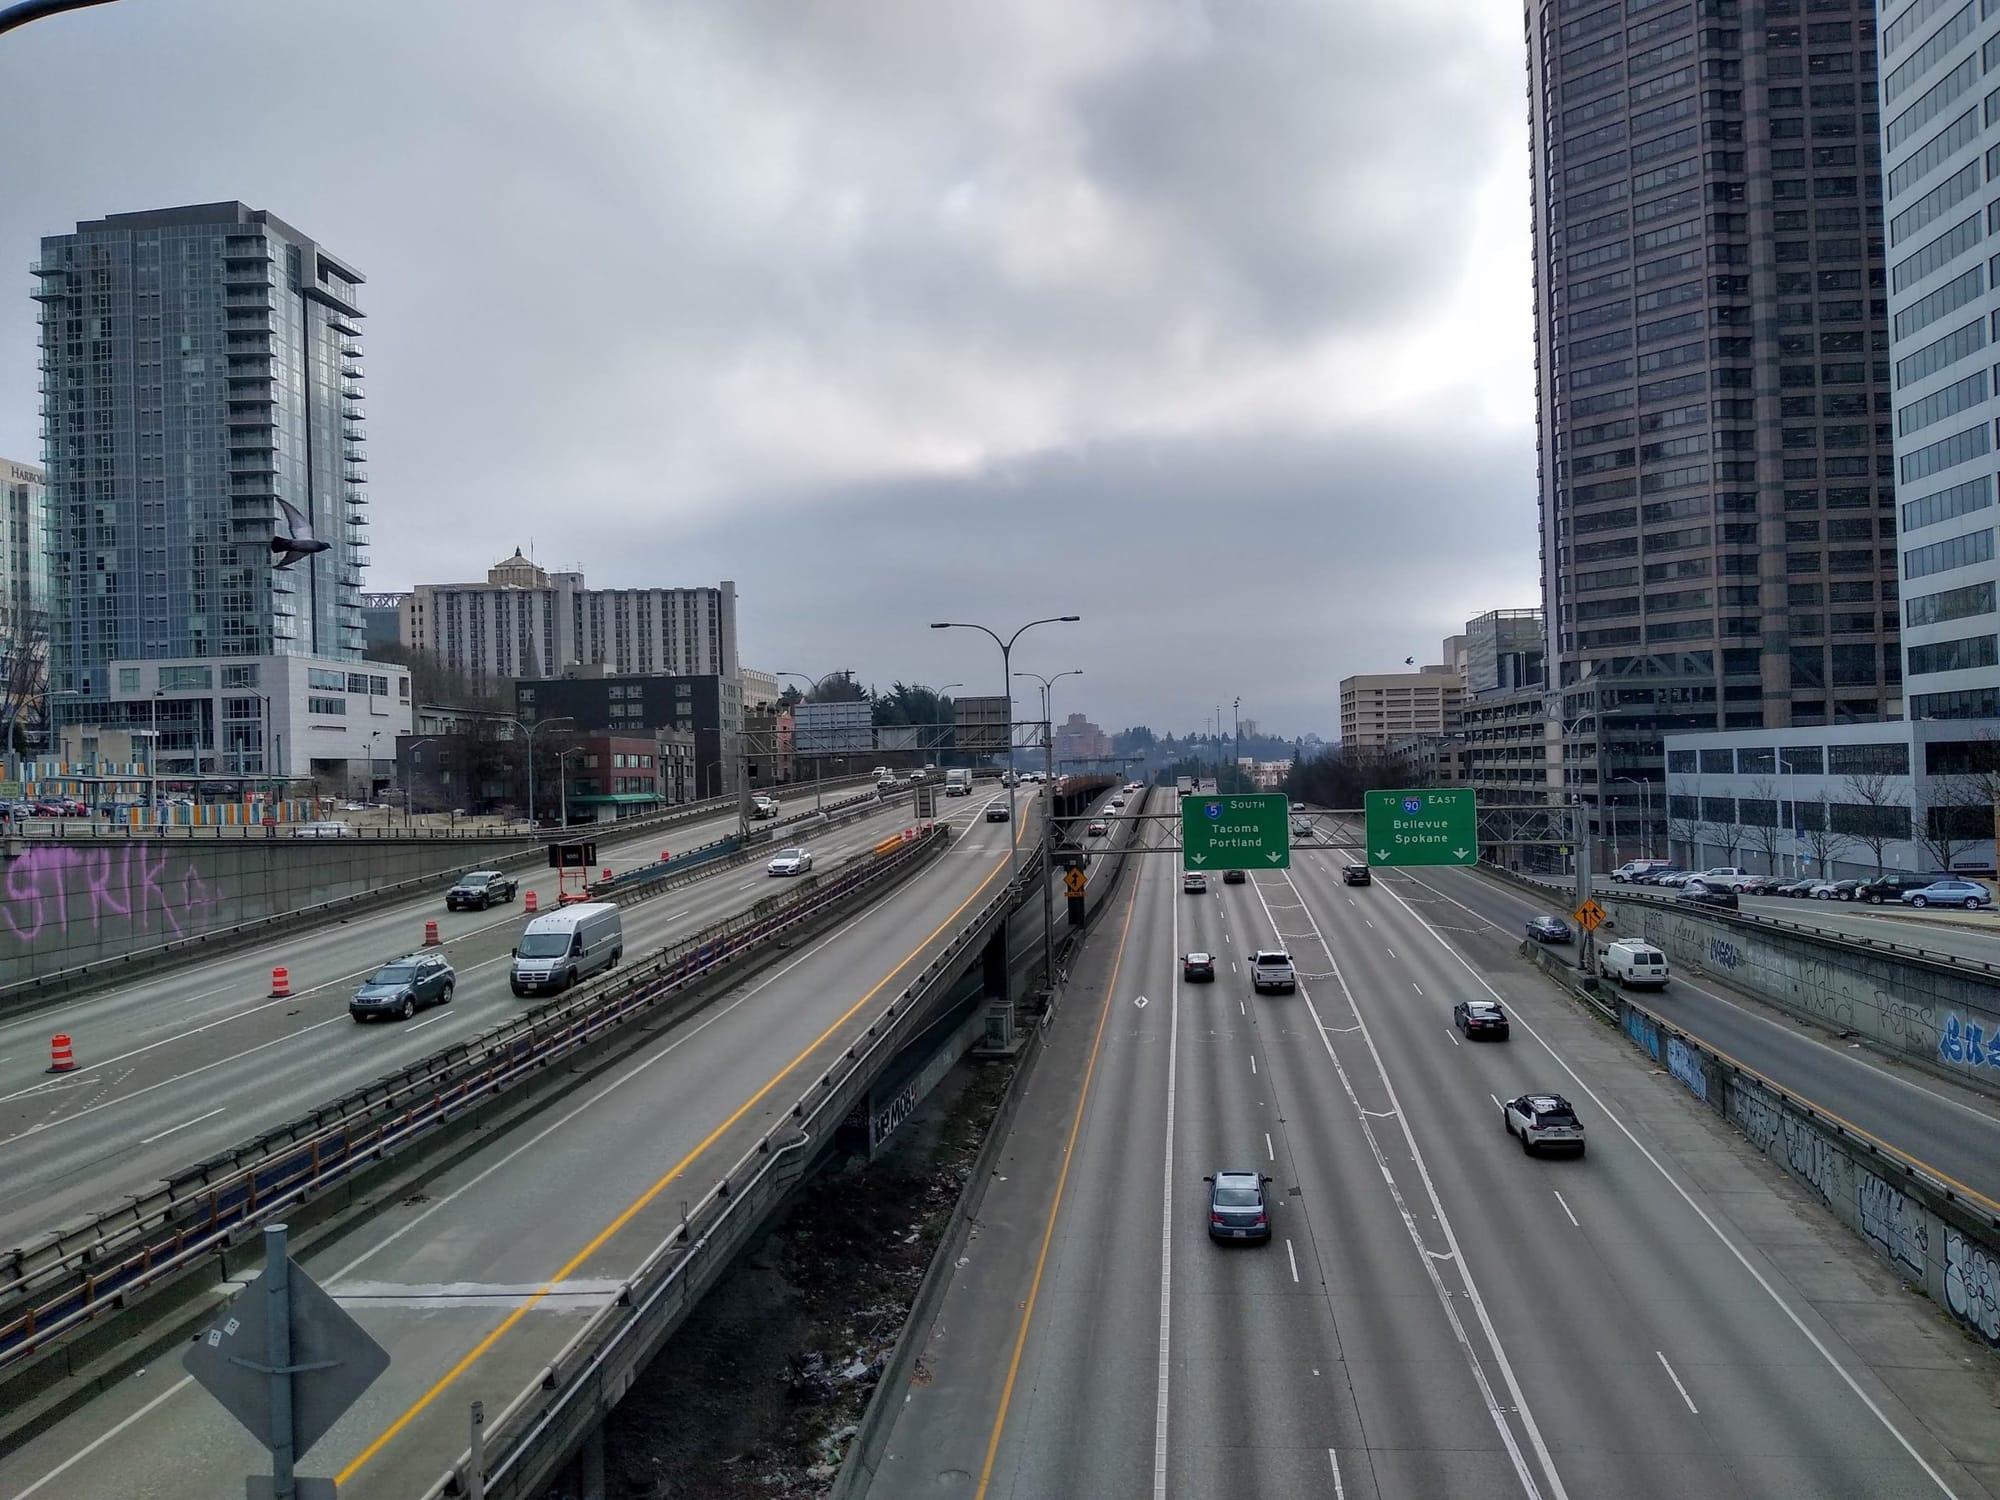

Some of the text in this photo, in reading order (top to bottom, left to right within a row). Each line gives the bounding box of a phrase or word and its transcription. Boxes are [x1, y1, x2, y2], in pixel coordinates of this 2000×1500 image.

[1210, 800, 1265, 816] 5 SOUTH
[1383, 795, 1457, 811] TO 90 EAST
[1211, 824, 1259, 833] Tacoma
[1393, 819, 1449, 829] Bellevue
[1209, 837, 1262, 848] Portland
[1395, 834, 1448, 845] Spokane
